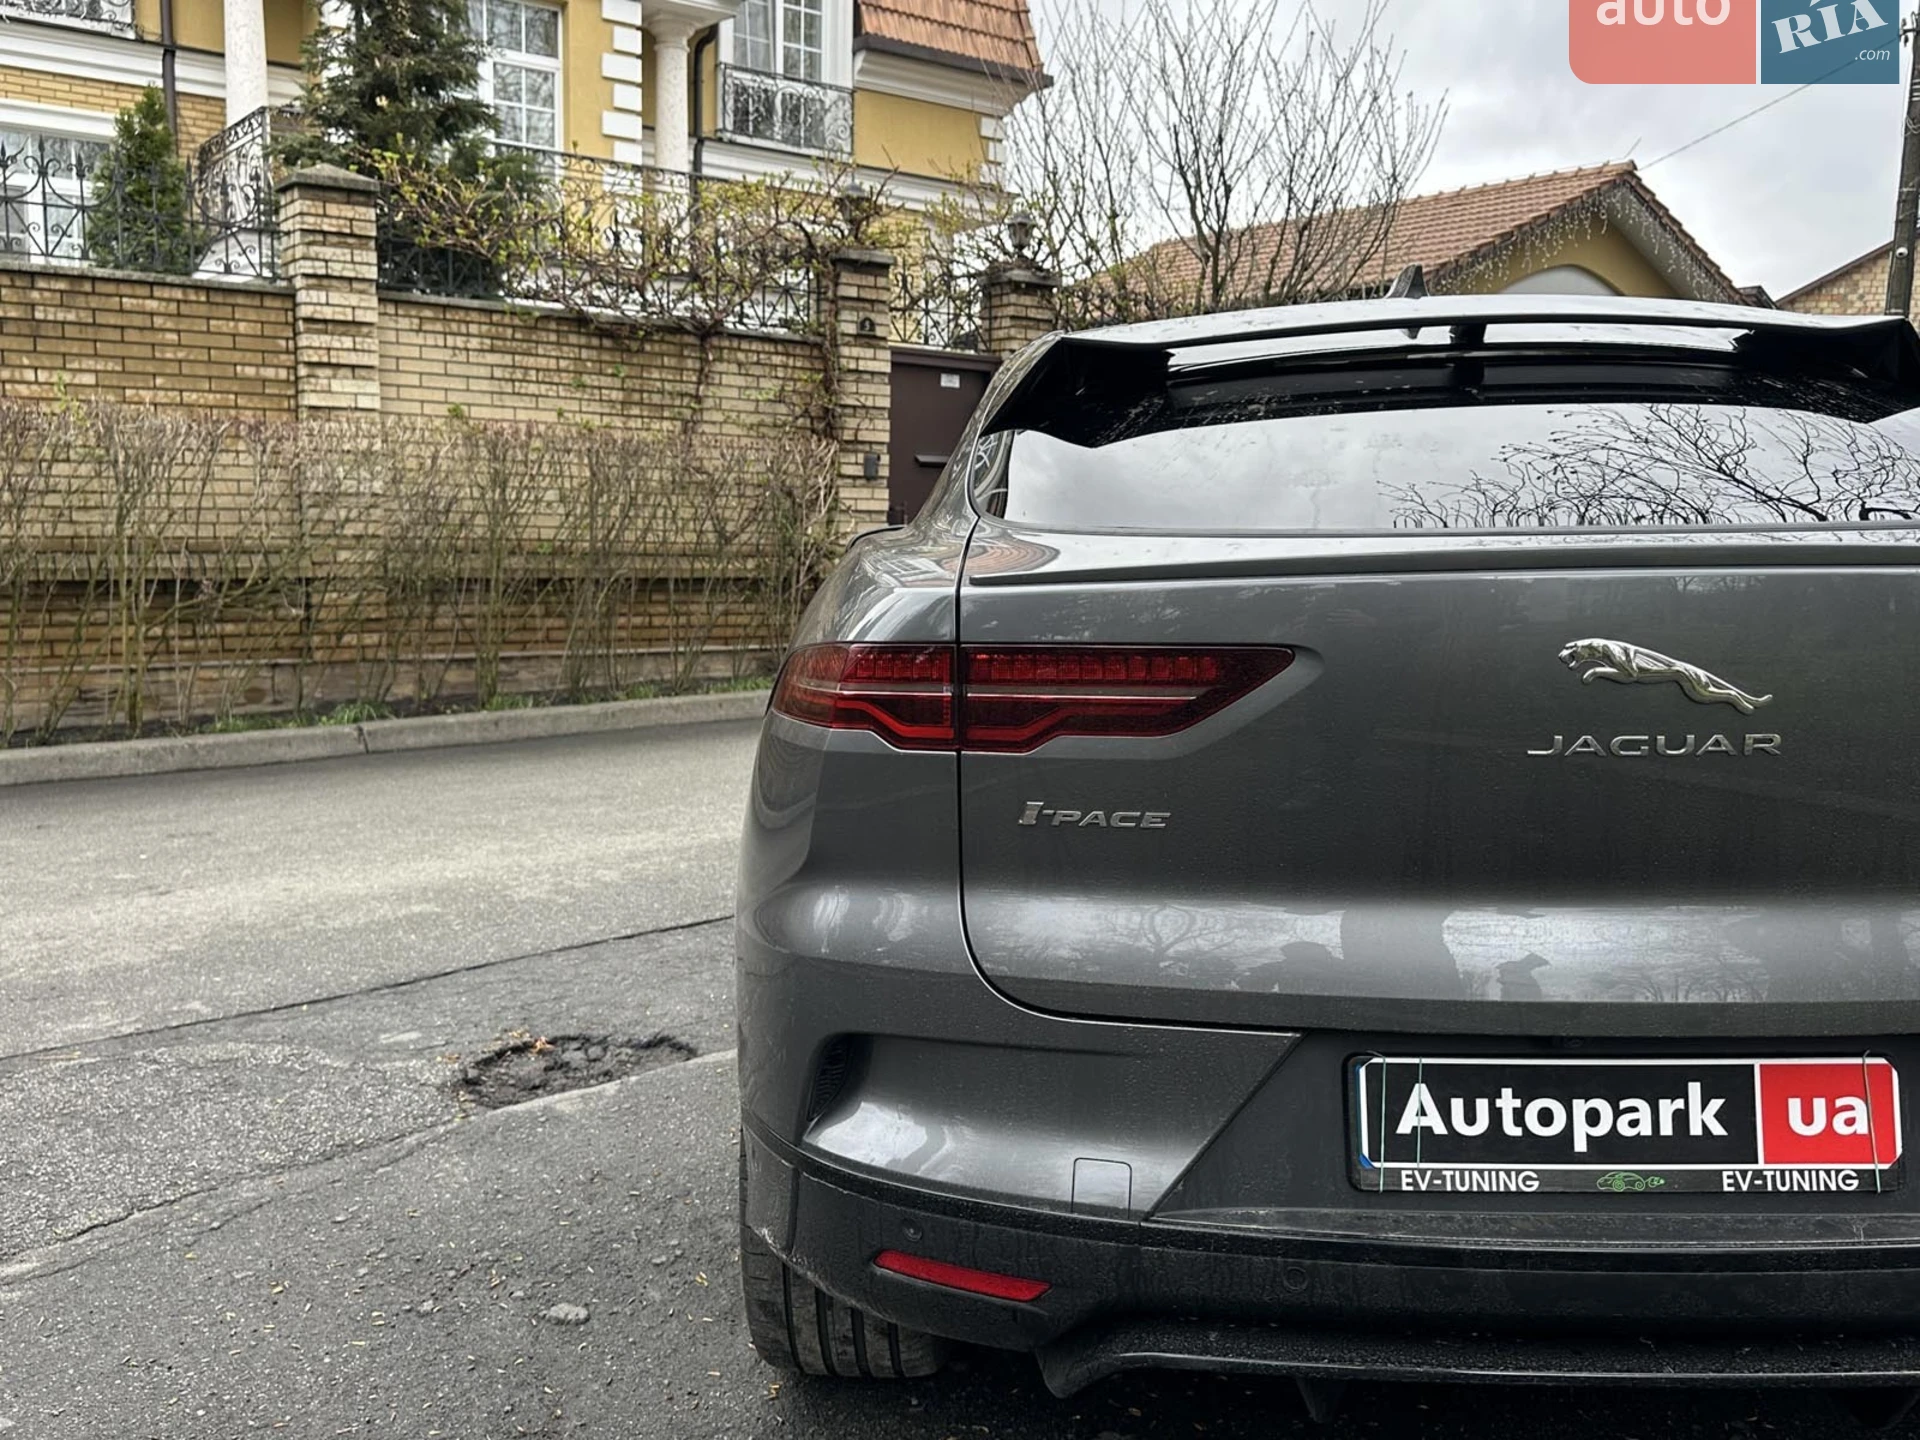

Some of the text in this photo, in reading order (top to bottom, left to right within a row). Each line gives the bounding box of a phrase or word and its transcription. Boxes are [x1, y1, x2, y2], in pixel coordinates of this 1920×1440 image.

[1527, 734, 1782, 757] JAGUAR
[1018, 801, 1172, 829] I-PACE
[1395, 1081, 1871, 1153] Autopark ua
[1400, 1169, 1860, 1193] EV-TUNING EV-TUNING
